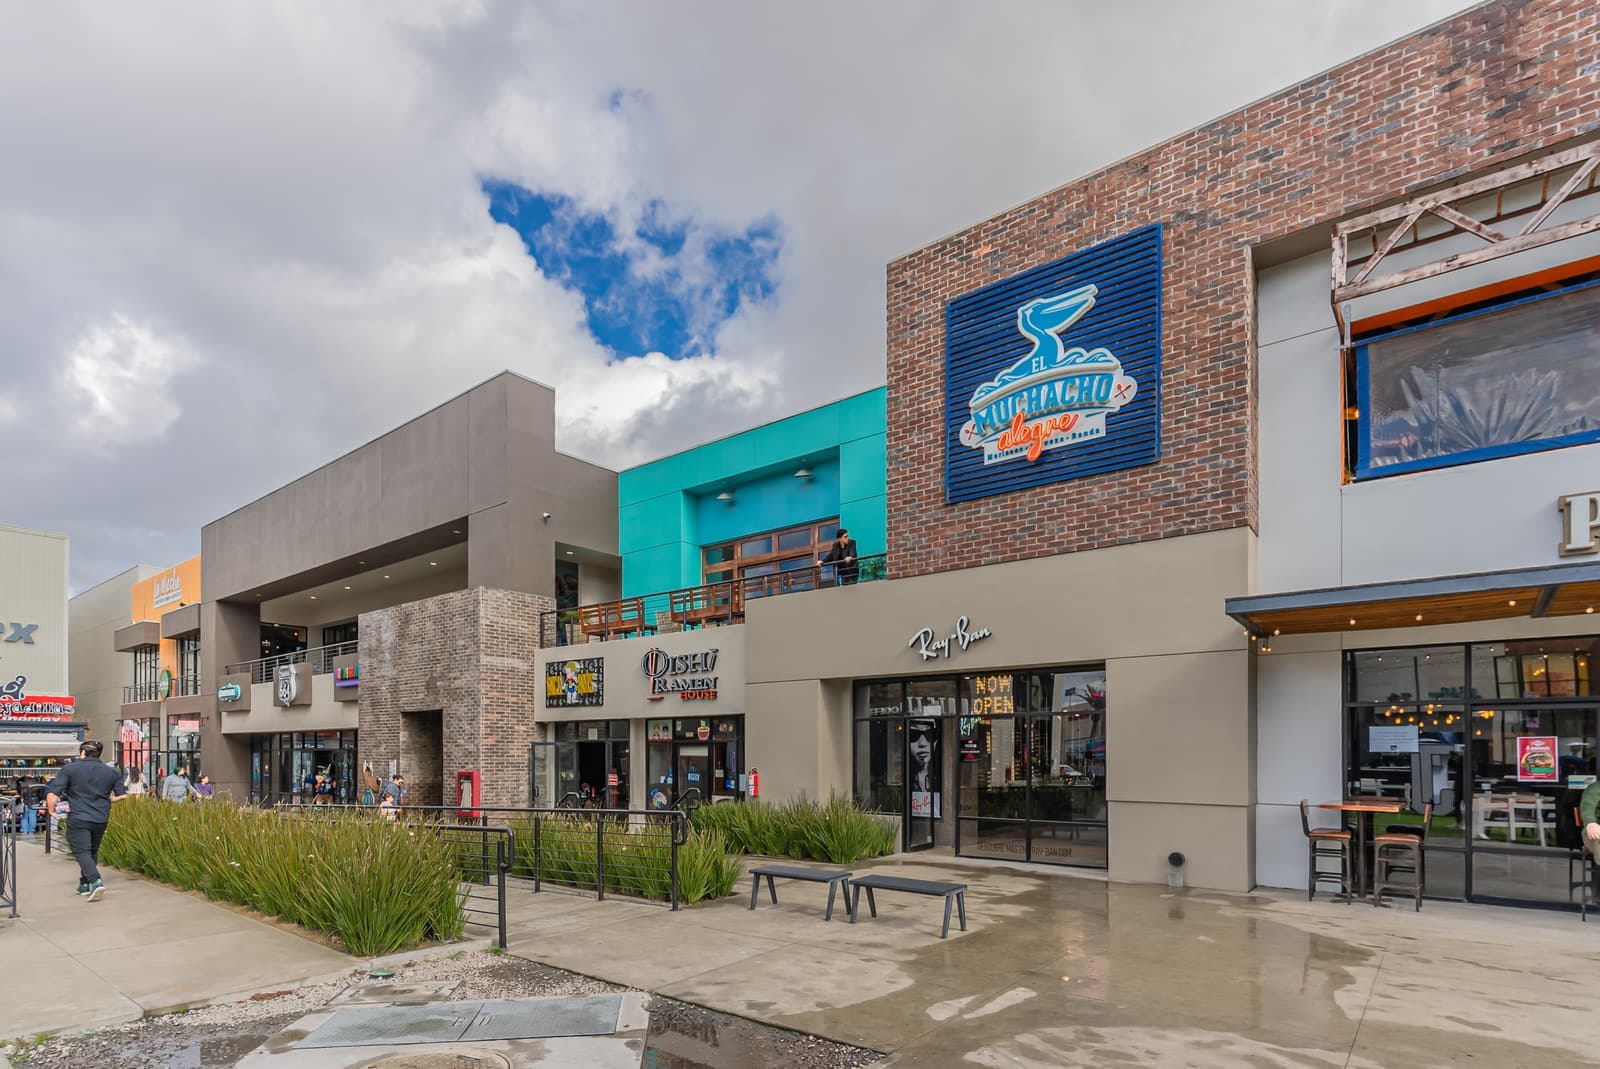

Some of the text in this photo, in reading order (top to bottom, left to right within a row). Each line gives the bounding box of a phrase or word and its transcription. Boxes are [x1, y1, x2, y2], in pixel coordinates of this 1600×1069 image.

[1031, 358, 1048, 373] EL
[972, 374, 1114, 436] MUCHACHO
[998, 412, 1079, 461] alegre
[908, 615, 991, 660] Ray-Ban
[655, 677, 719, 693] RAMEN
[679, 689, 718, 700] HOUSE
[976, 674, 1013, 695] NOW
[973, 695, 1014, 715] OPEN
